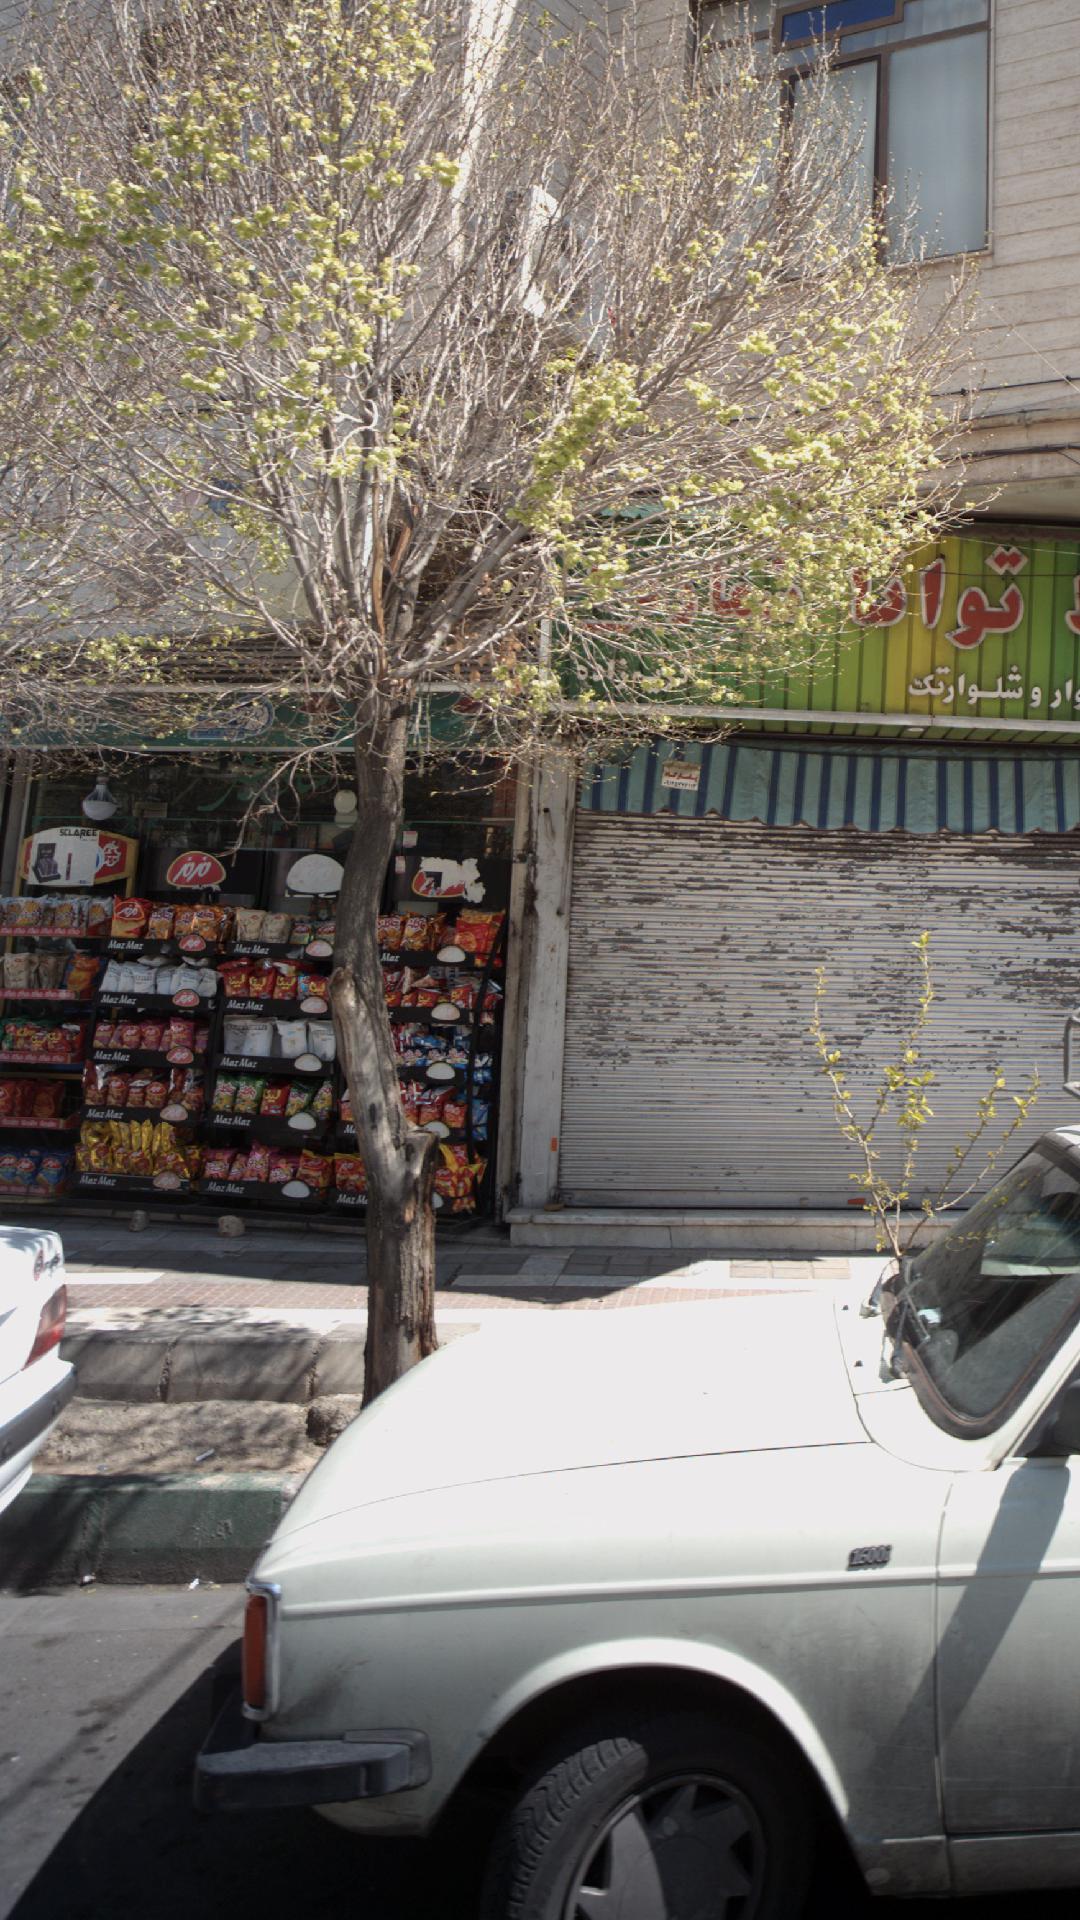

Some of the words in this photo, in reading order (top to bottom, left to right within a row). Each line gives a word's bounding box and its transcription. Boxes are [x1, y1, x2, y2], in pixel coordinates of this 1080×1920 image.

[108, 940, 125, 950] Maz
[127, 941, 144, 951] Maz
[100, 994, 118, 1005] Maz
[119, 995, 136, 1006] Maz
[226, 1000, 244, 1010] Maz
[246, 1001, 264, 1011] Maz
[94, 1051, 112, 1062] Maz
[113, 1052, 130, 1062] Maz
[220, 1057, 238, 1067] Maz
[239, 1058, 257, 1068] Maz
[86, 1109, 105, 1119] Maz
[105, 1110, 124, 1119] Maz
[214, 1114, 232, 1125] Maz
[233, 1115, 251, 1126] Maz
[80, 1175, 97, 1185] Maz
[98, 1176, 116, 1186] Maz
[207, 1182, 225, 1193] Maz
[226, 1183, 245, 1194] Maz
[337, 1194, 356, 1204] Maz
